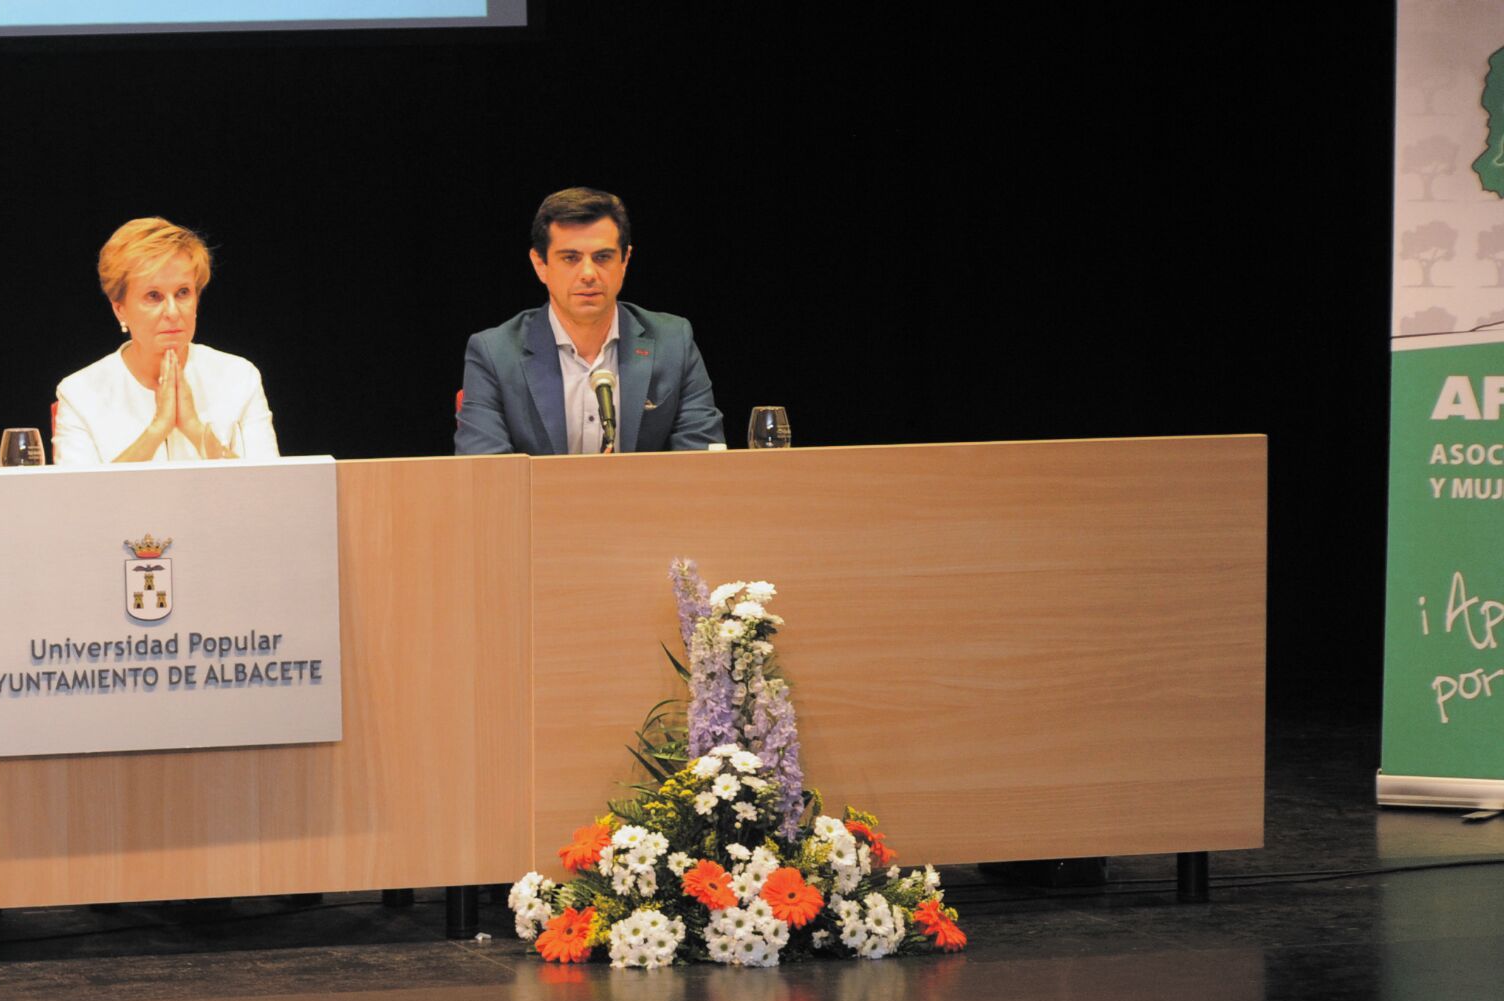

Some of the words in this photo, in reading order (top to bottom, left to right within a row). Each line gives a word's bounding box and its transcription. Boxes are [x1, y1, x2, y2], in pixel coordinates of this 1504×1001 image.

[1429, 443, 1504, 465] ASOC
[1429, 477, 1447, 499] Y
[1451, 477, 1504, 499] MUJ
[31, 633, 178, 661] Universidad
[188, 629, 283, 658] Popular
[168, 665, 198, 686] DE
[203, 659, 323, 686] ALBACETE
[1431, 668, 1504, 724] por
